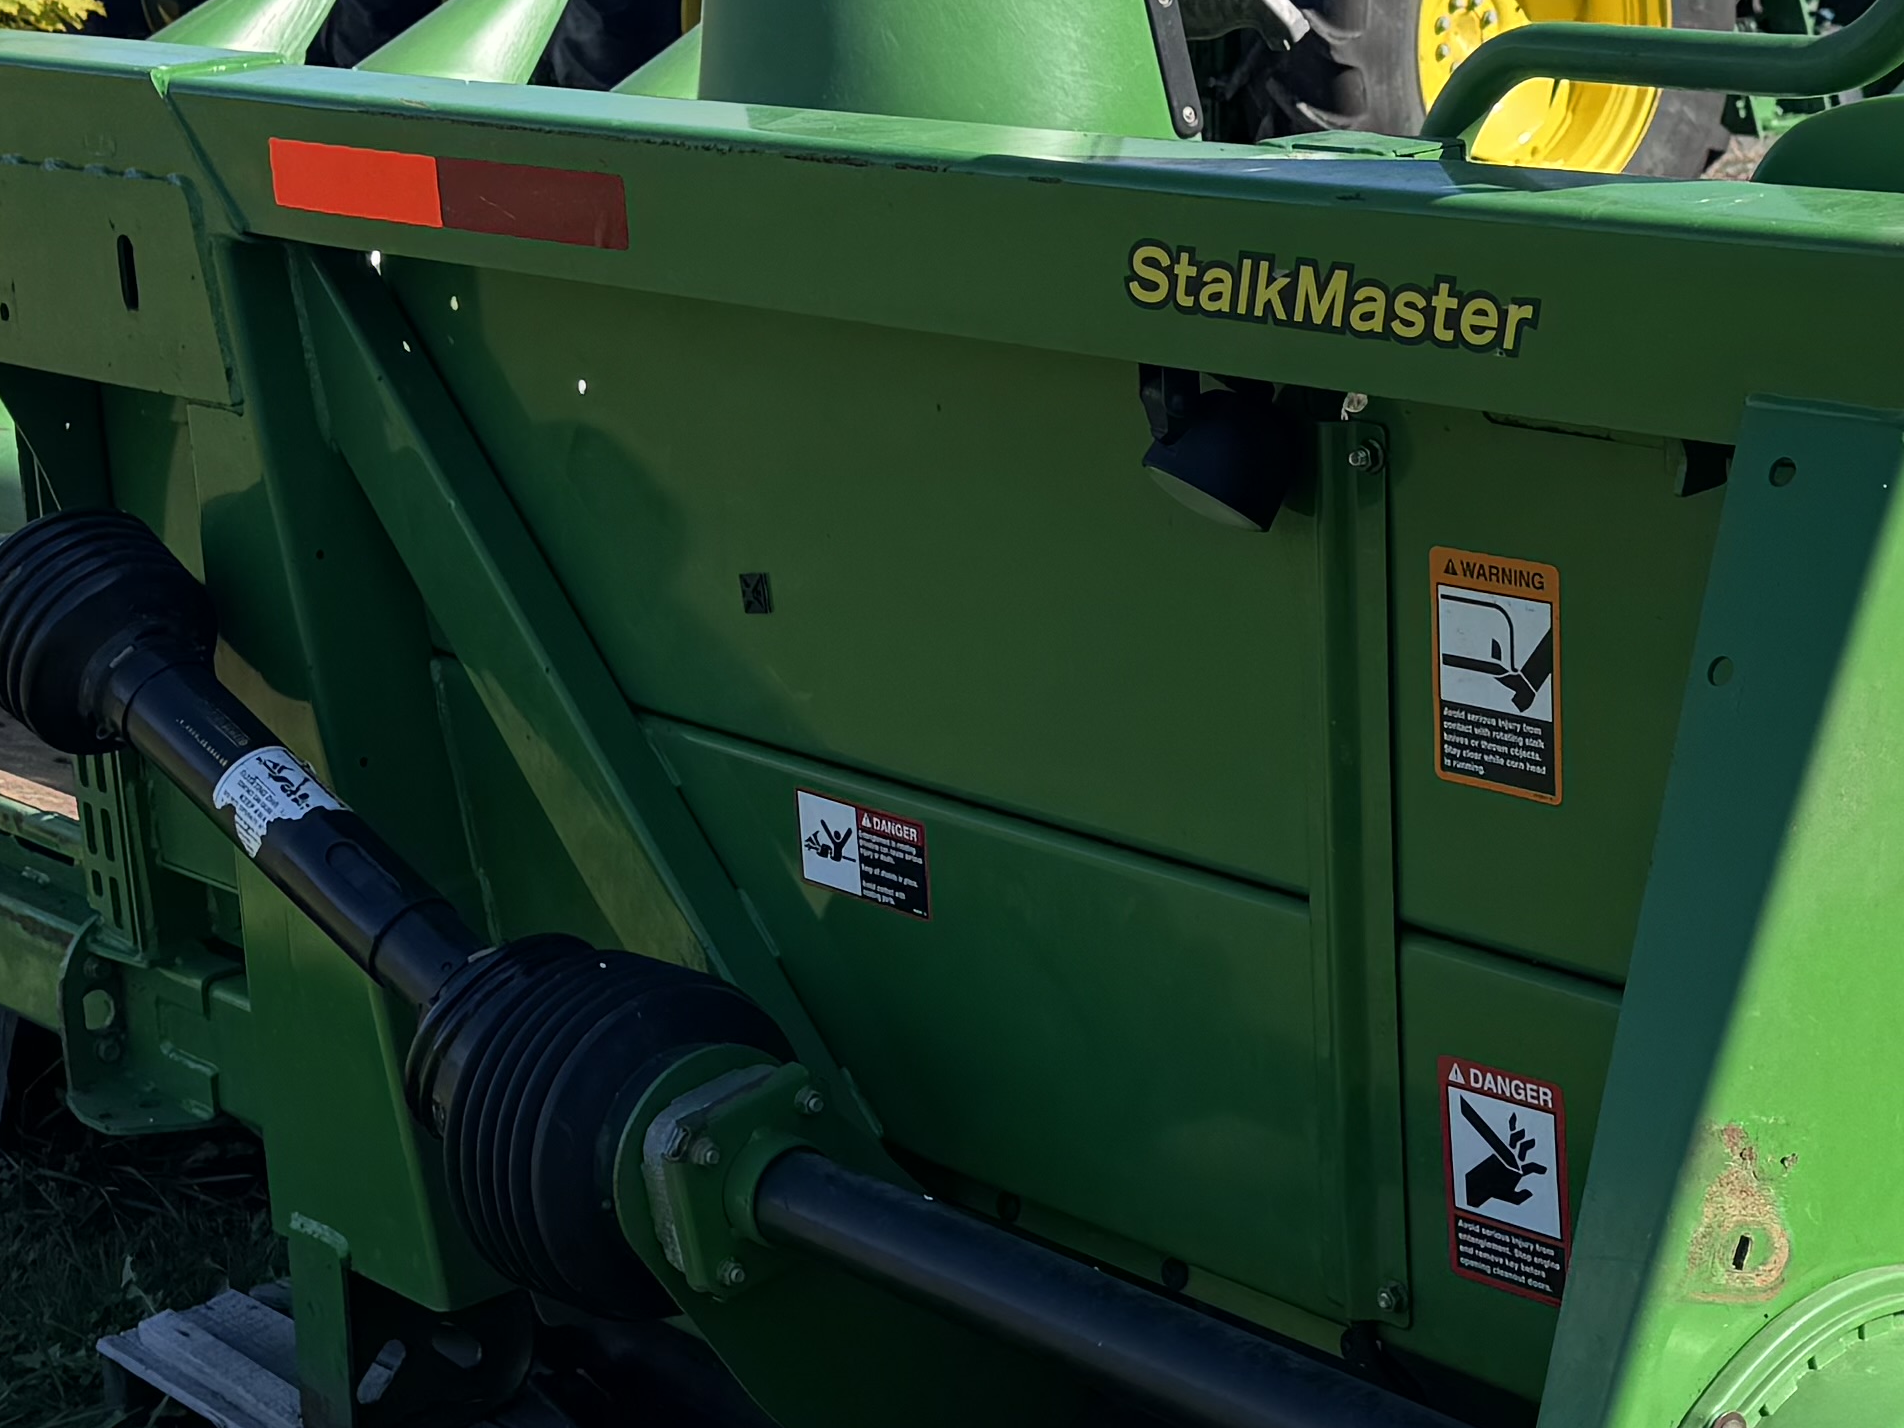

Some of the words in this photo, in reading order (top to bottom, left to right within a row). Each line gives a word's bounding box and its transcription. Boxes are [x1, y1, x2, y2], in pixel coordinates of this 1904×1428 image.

[1127, 244, 1534, 351] StalkMaster
[1460, 560, 1545, 591] WARNING
[873, 817, 917, 842] DANGER
[1470, 1068, 1553, 1109] DANGER
